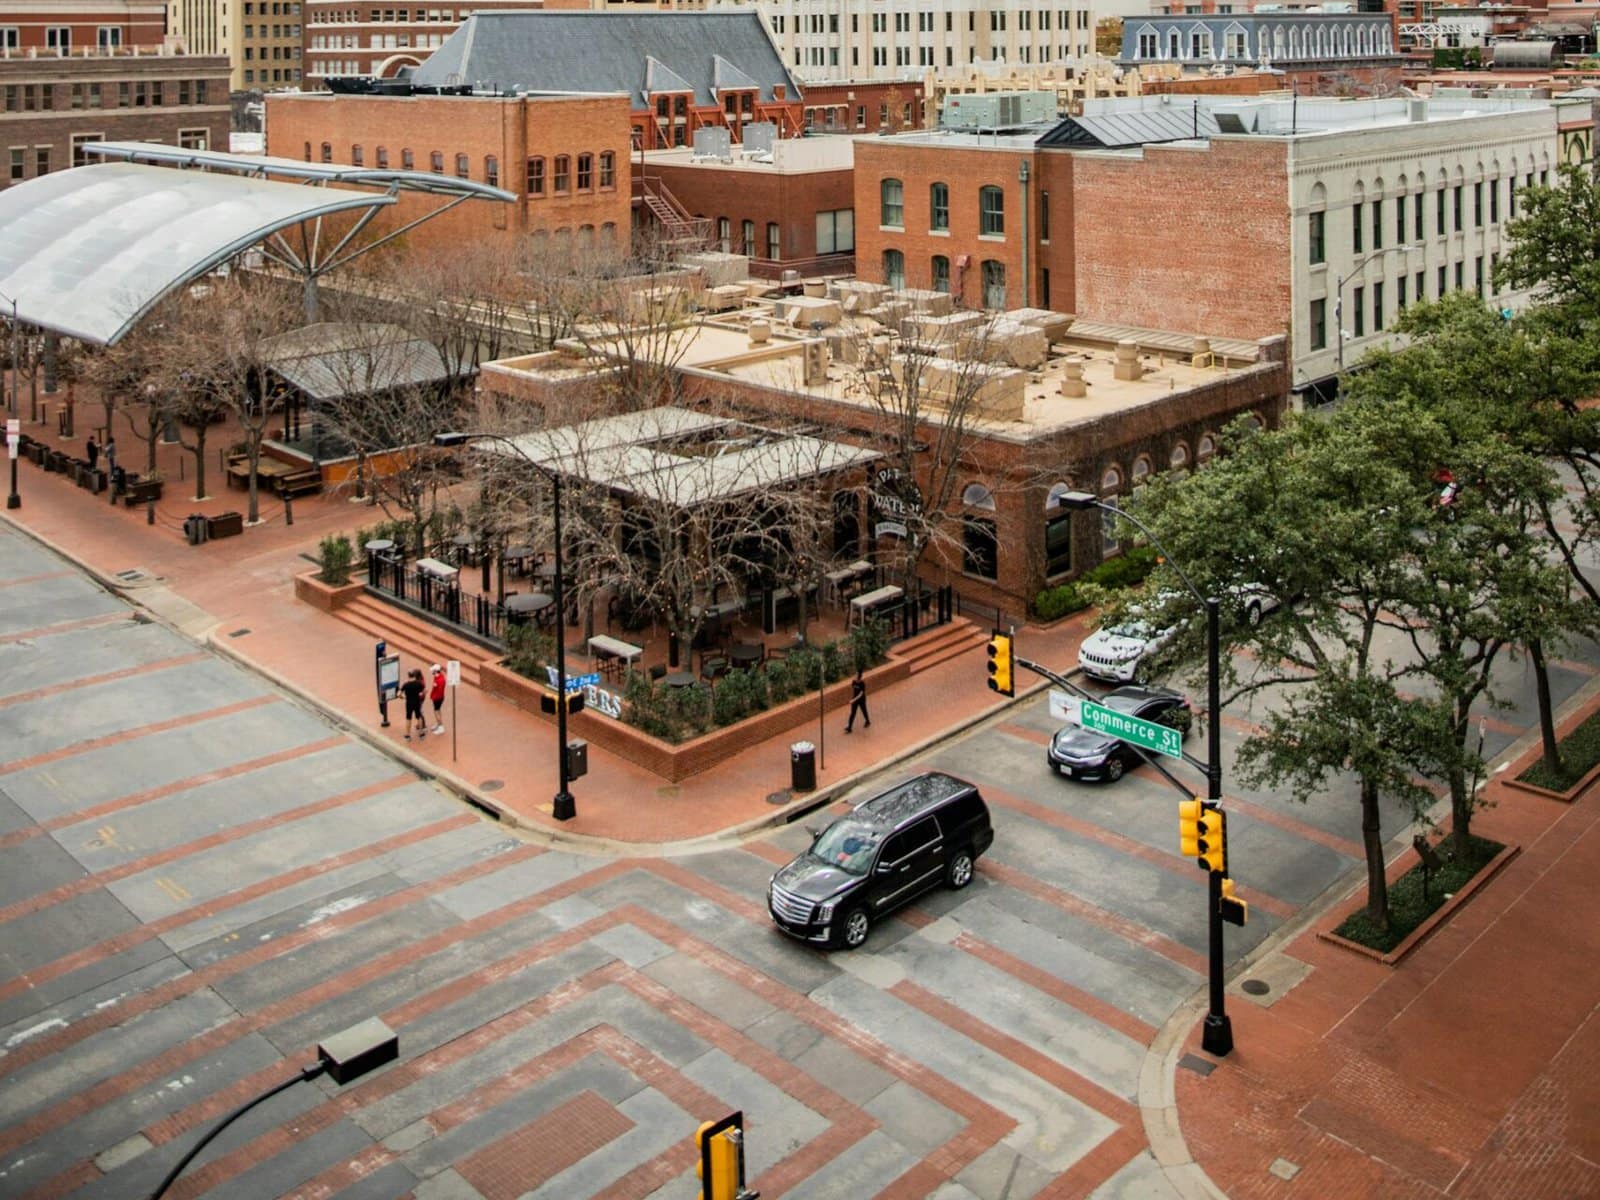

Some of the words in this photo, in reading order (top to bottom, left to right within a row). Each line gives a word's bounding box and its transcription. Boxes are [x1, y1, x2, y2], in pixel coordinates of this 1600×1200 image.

[546, 666, 621, 715] WERS
[1083, 704, 1155, 740] Commerce
[1162, 730, 1177, 748] St
